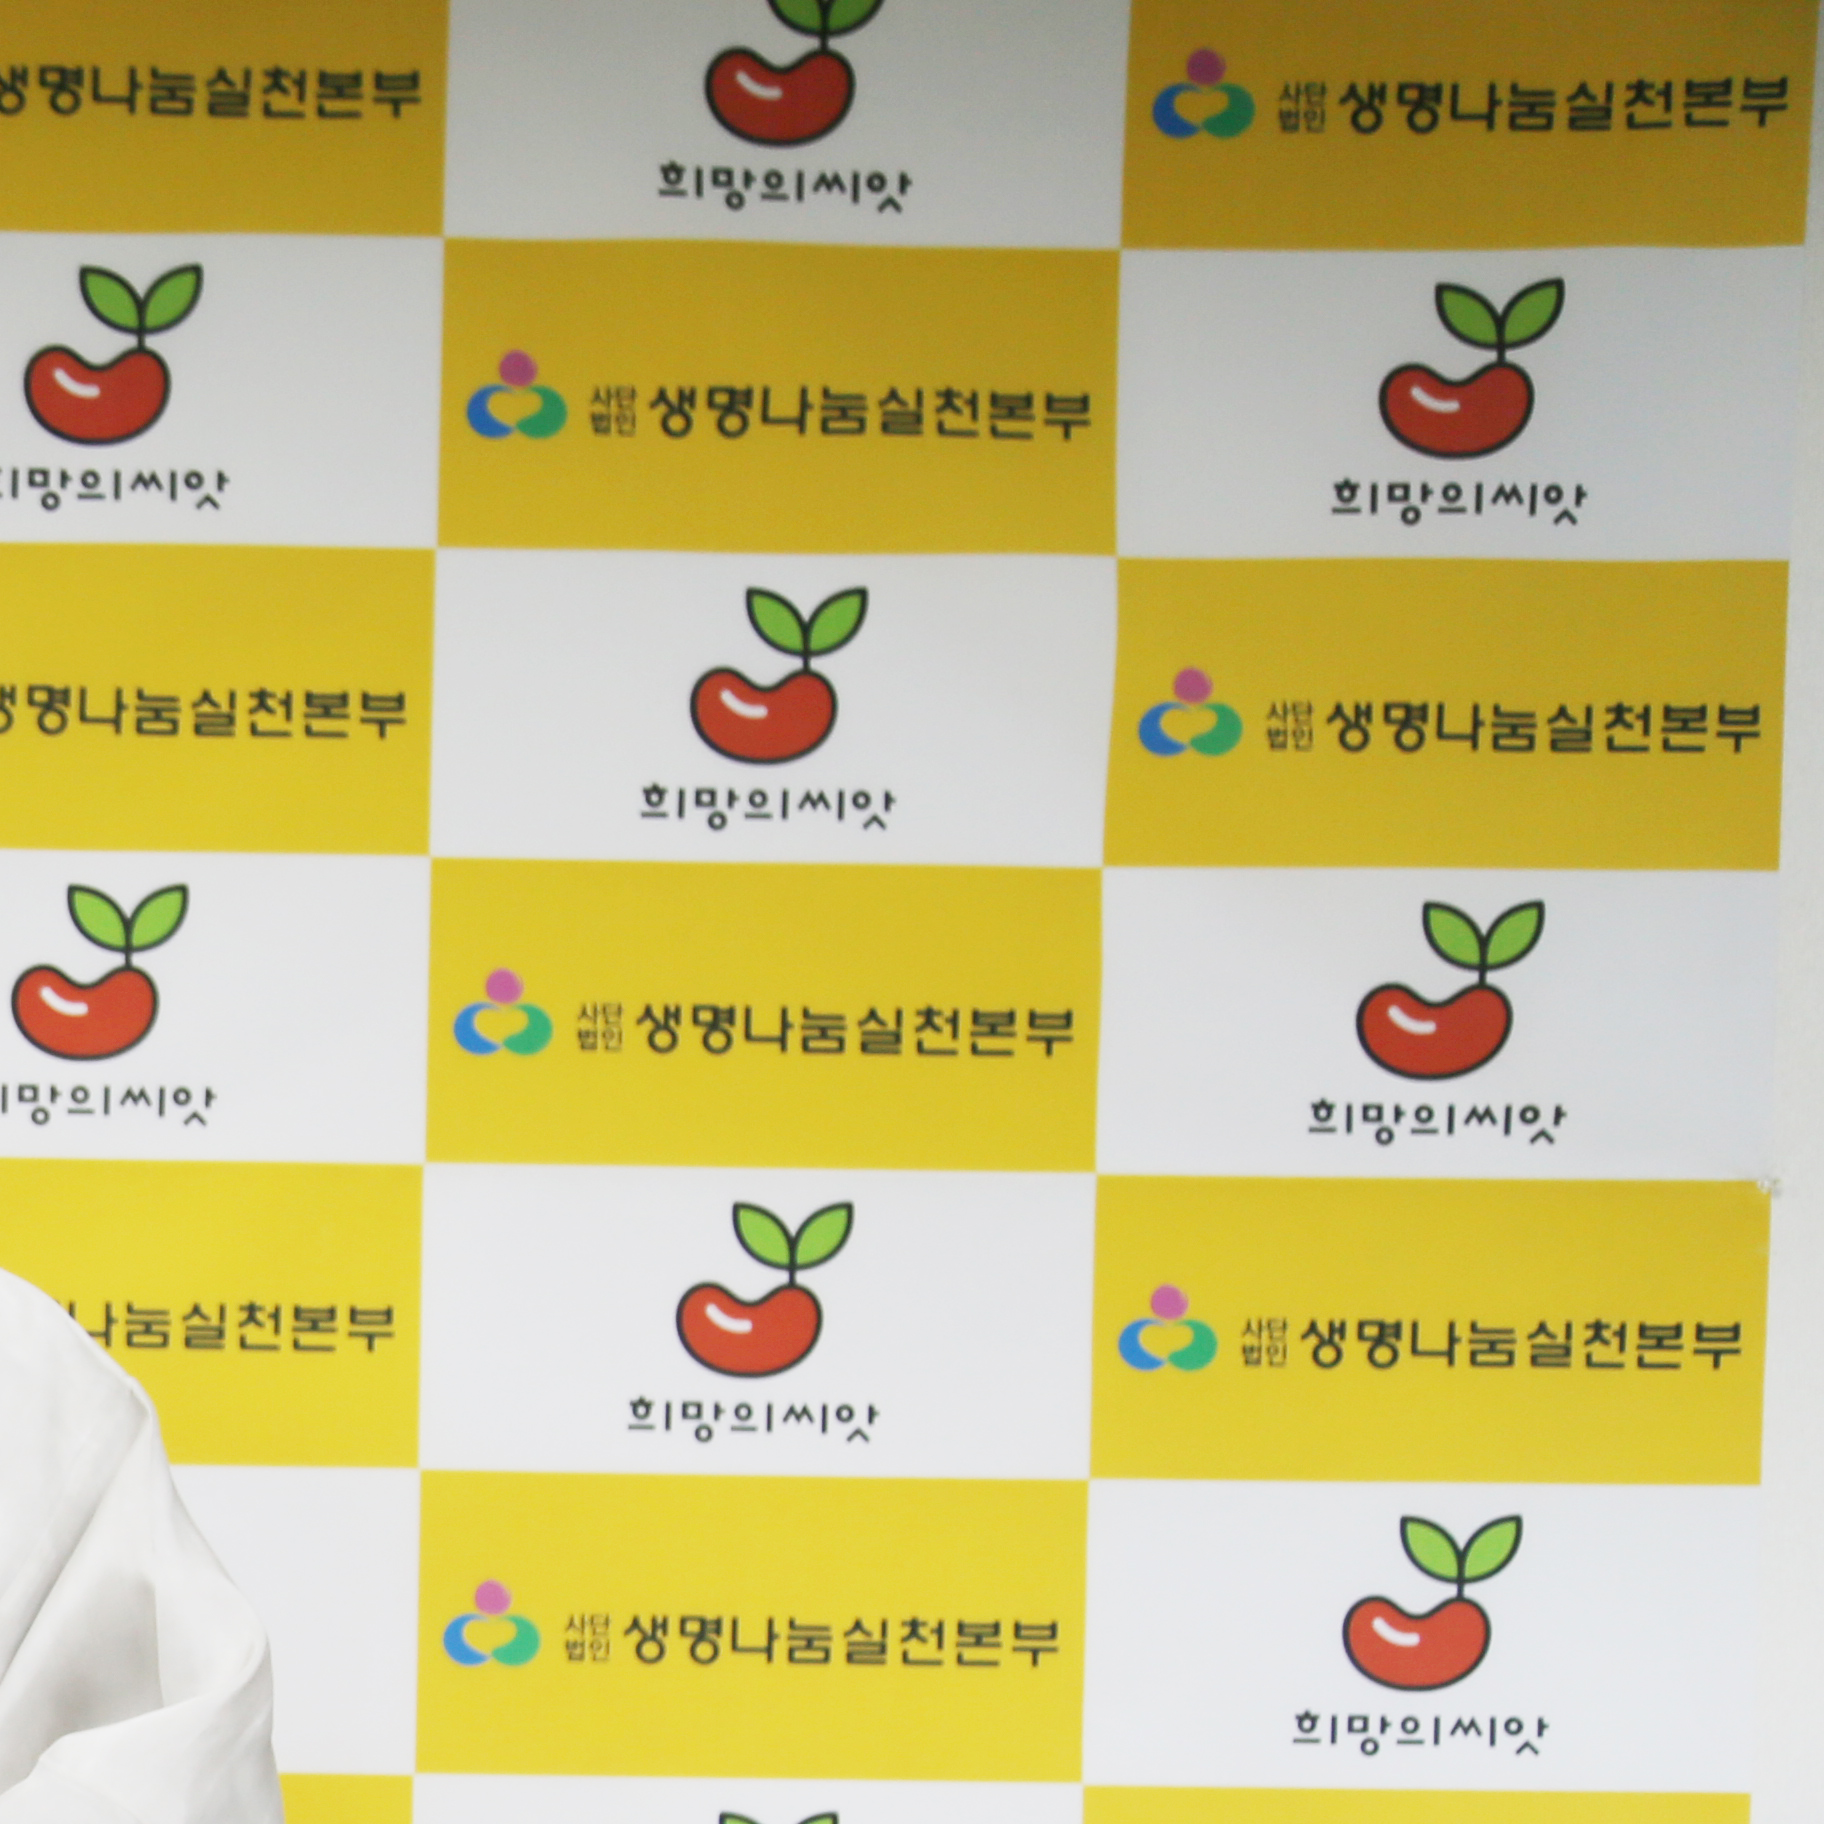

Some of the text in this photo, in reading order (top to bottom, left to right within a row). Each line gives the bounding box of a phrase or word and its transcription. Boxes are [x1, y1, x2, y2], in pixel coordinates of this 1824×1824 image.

[1337, 73, 1791, 136] 생명나눔실천본부
[658, 160, 913, 214] 희망의씨앗
[649, 384, 1092, 441] 생명나눔실천본부
[1331, 477, 1588, 527] 희망의씨앗
[1326, 701, 1762, 754] 생명나눔실천본부
[640, 782, 896, 831] 희망의씨앗
[636, 1003, 1074, 1058] 생명나눔실천본부
[1308, 1097, 1567, 1146] 희망의씨앗
[1300, 1318, 1742, 1370] 생명나눔실천본부
[628, 1396, 879, 1443] 희망의씨앗
[624, 1615, 1059, 1668] 생명나눔실천본부
[1293, 1710, 1549, 1756] 희망의씨앗
